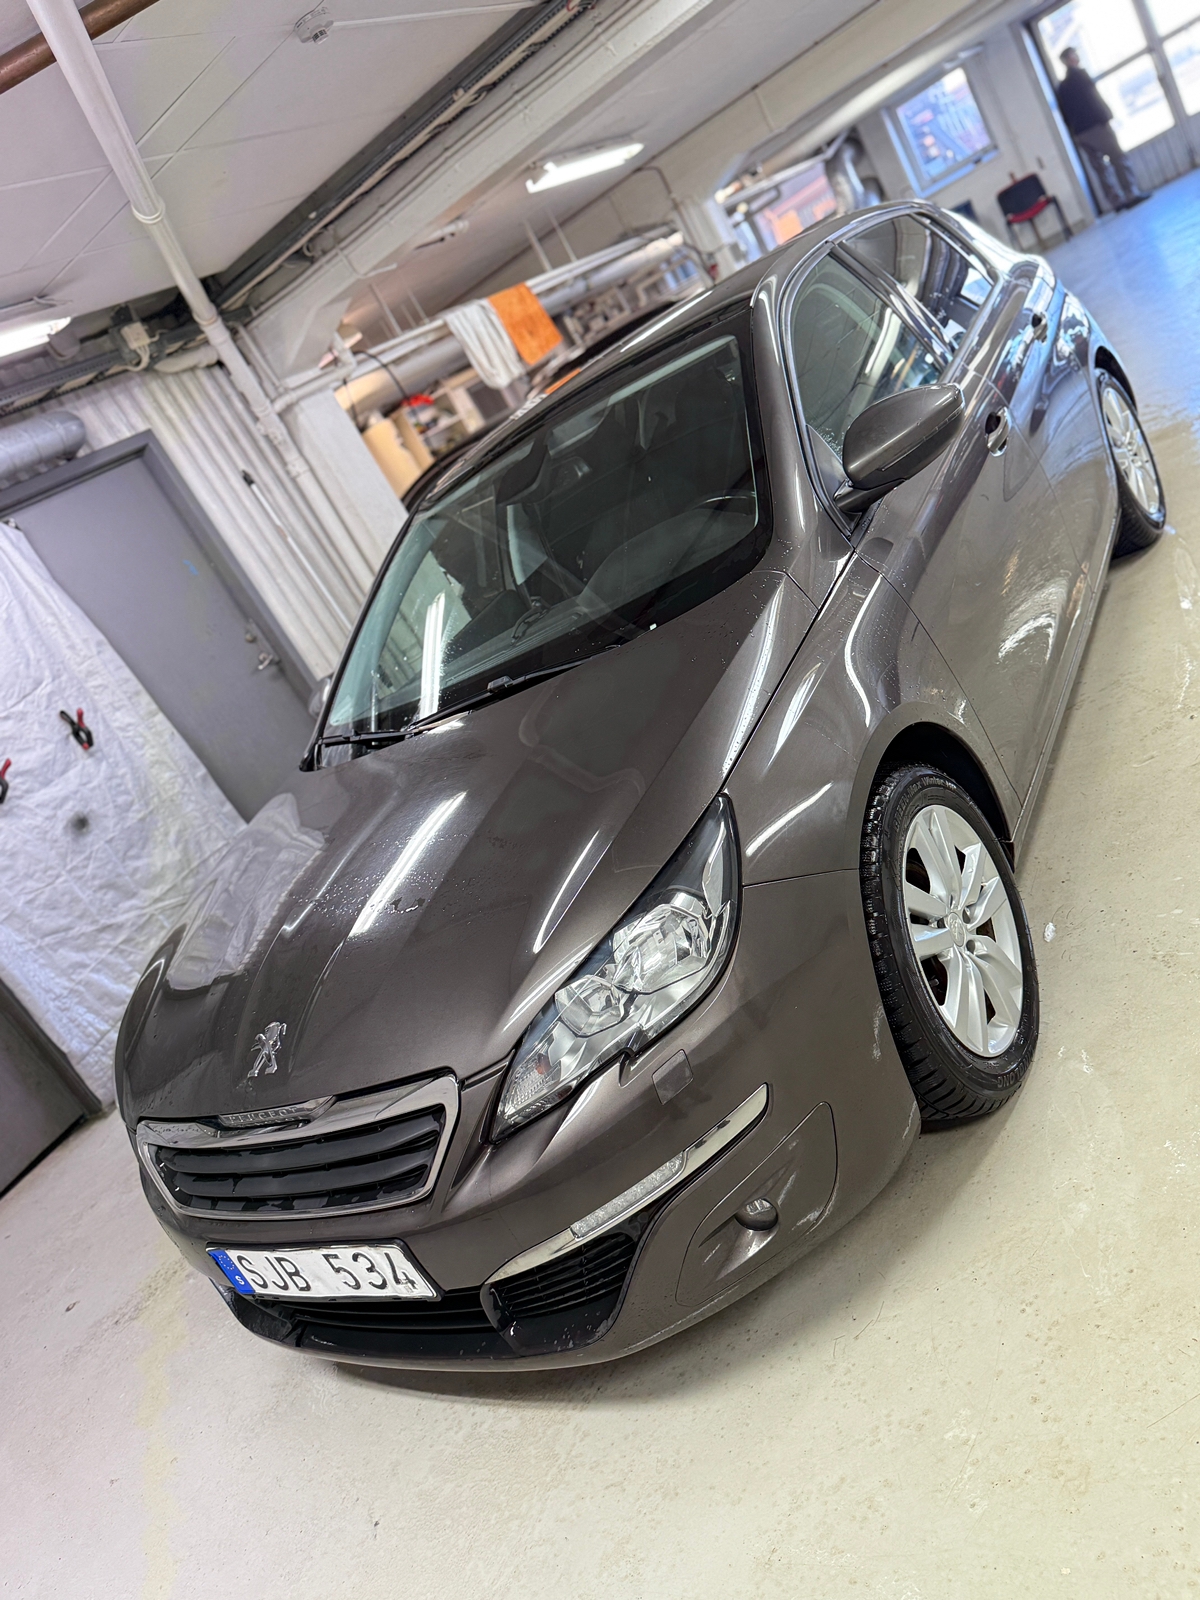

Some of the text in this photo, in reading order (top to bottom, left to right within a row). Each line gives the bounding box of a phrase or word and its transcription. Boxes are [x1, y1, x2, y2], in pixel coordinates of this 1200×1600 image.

[228, 1106, 298, 1123] PEUGEOT
[236, 1251, 419, 1292] SJB 534
[235, 1275, 245, 1286] S
